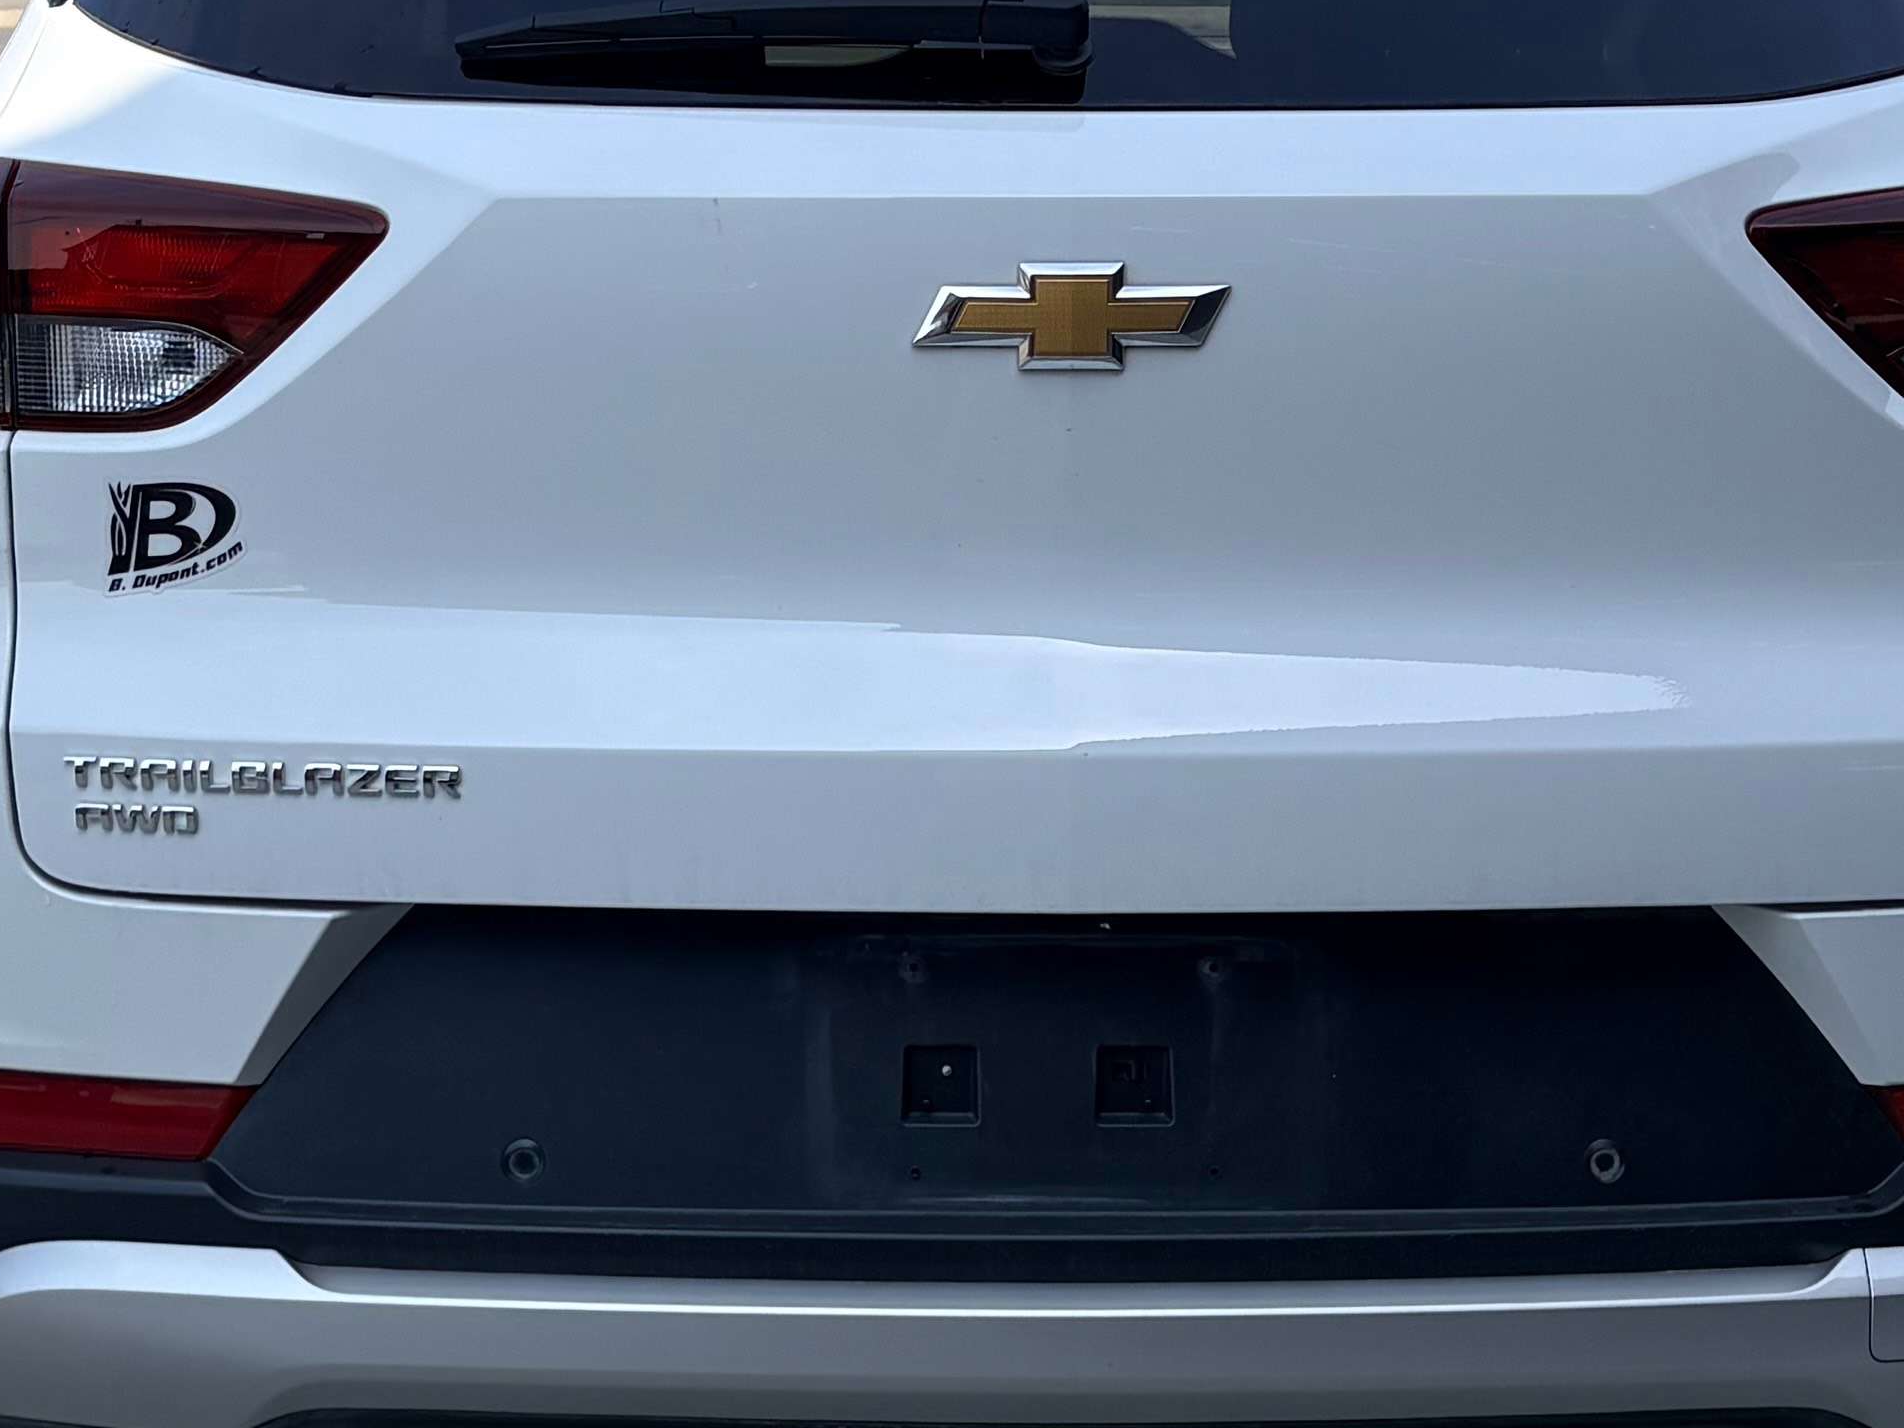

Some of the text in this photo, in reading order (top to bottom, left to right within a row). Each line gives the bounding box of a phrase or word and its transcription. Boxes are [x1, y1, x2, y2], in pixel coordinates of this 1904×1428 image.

[132, 541, 243, 589] Dupont.com
[63, 755, 463, 800] TRAILBLAZER
[74, 802, 198, 835] AWD
